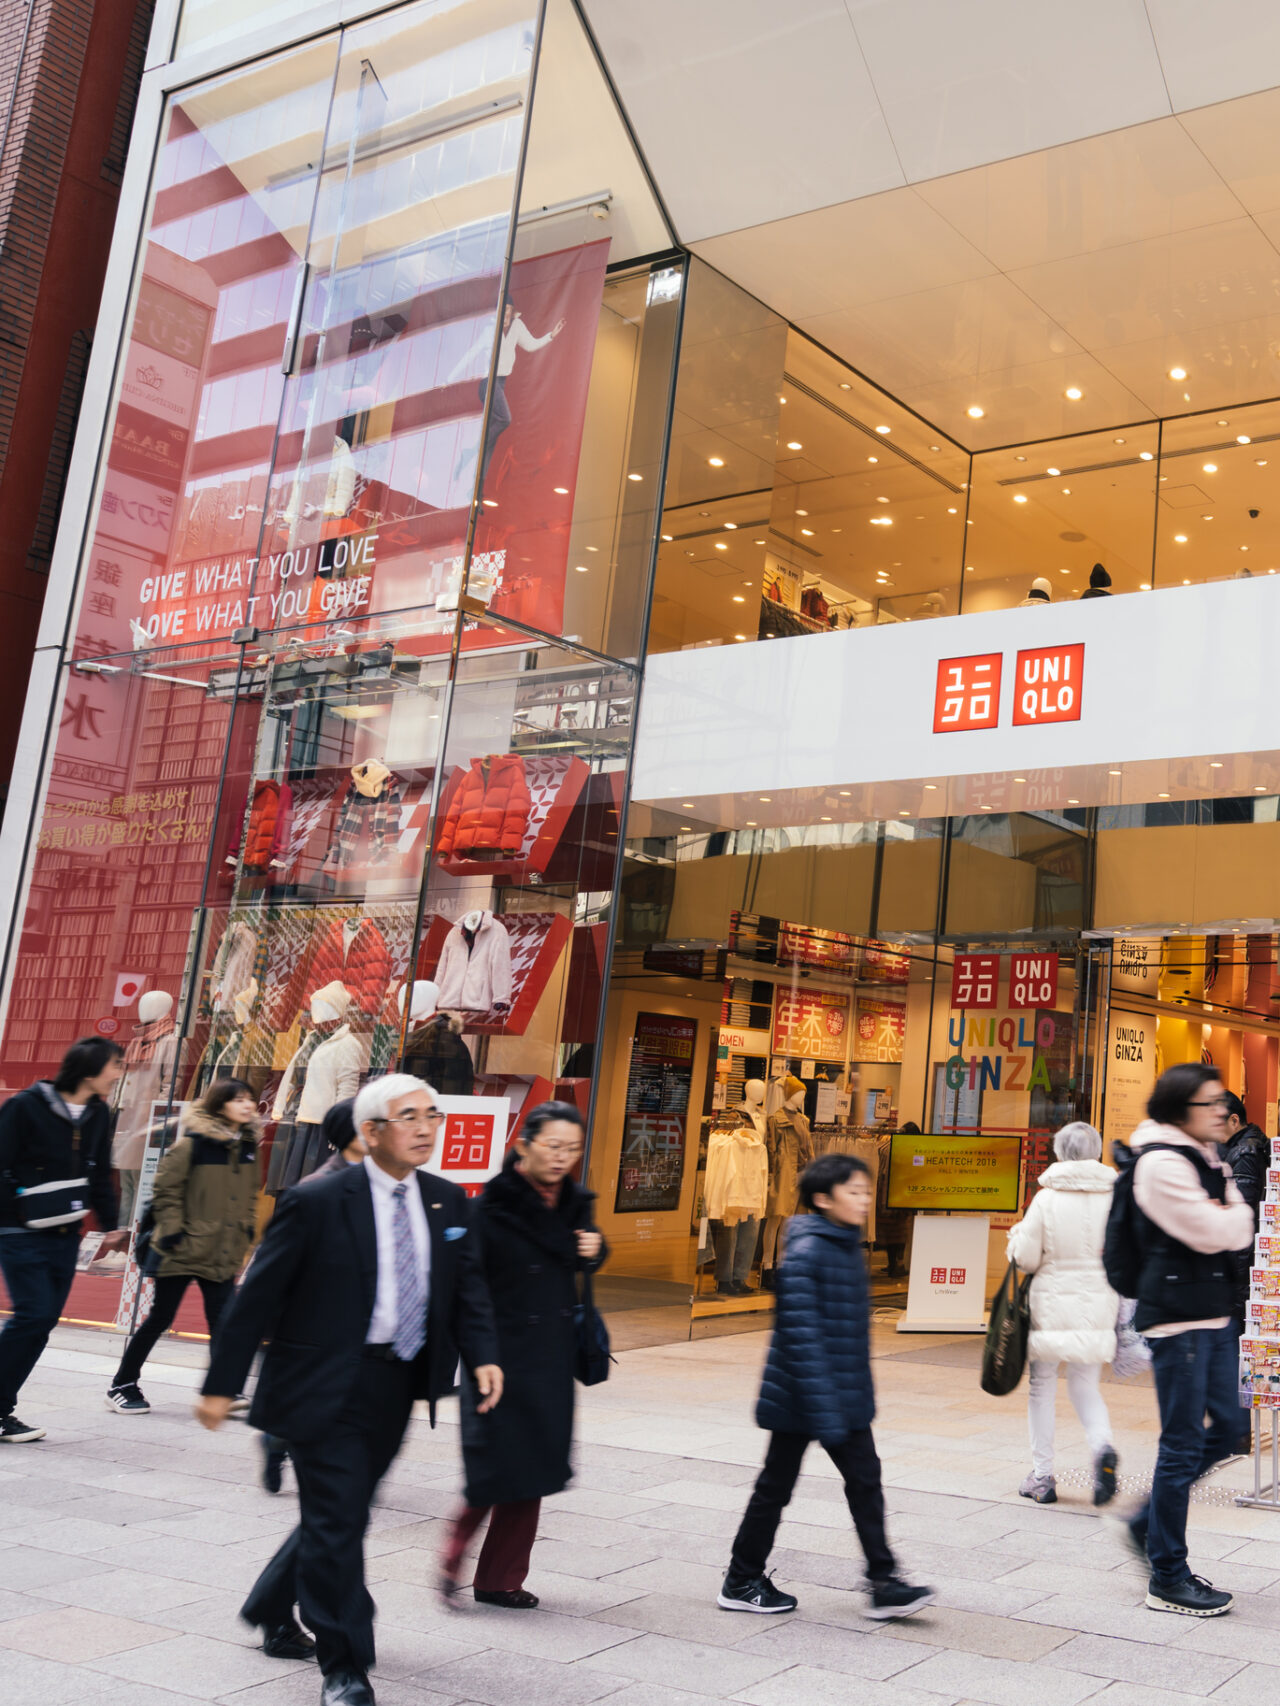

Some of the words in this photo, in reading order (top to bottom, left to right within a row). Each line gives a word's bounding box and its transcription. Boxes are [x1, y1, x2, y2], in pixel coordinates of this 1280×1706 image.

[140, 571, 187, 605] GIVE
[195, 558, 260, 594] WHAT
[268, 548, 311, 582] YOU
[317, 534, 381, 573] LOVE
[195, 596, 260, 632] WHAT
[270, 588, 312, 621] YOU
[320, 576, 373, 612] GIVE
[945, 664, 992, 692] ユニ
[1023, 655, 1071, 684] UNI
[941, 695, 991, 723] クロ
[1021, 686, 1074, 719] QLO
[958, 961, 993, 980] ユニ
[1015, 960, 1050, 979] UNI
[956, 983, 992, 1002] クロ
[1014, 983, 1052, 1005] QLO
[948, 1017, 1055, 1053] UNIQLO
[1116, 1026, 1145, 1045] UNIQLO
[1115, 1044, 1144, 1063] GINZA
[945, 1055, 1052, 1091] GINZA
[451, 1121, 486, 1139] ユニ
[447, 1144, 484, 1162] クロ
[926, 1156, 973, 1167] HEATTECH
[976, 1158, 997, 1167] 2018
